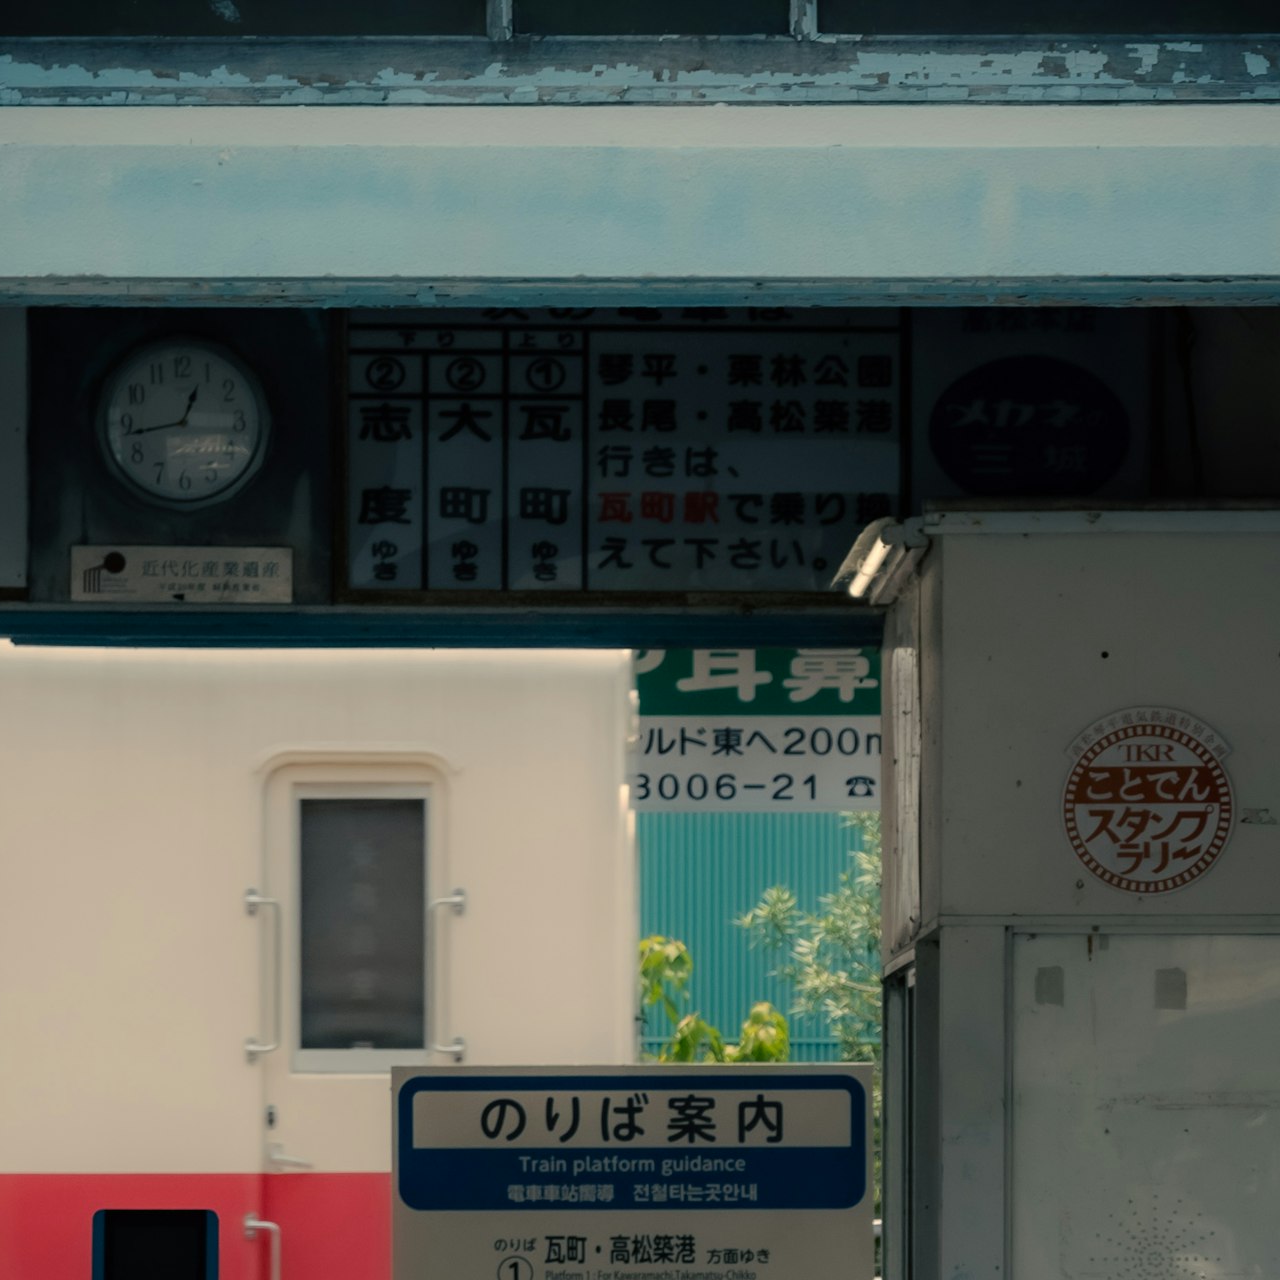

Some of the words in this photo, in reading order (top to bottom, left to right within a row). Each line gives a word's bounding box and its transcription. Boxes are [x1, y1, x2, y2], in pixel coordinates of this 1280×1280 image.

[150, 362, 164, 385] 11
[173, 355, 191, 378] 12
[203, 362, 211, 384] 1
[128, 382, 145, 405] 10
[222, 379, 236, 402] 2
[120, 412, 134, 436] 9
[232, 409, 247, 433] 3
[130, 441, 145, 464] 8
[223, 439, 235, 461] 4
[153, 462, 165, 485] 7
[178, 469, 192, 491] 6
[204, 460, 218, 482] 5
[1086, 768, 1210, 802] ことでん
[1085, 804, 1215, 844] スタンプ
[1116, 841, 1204, 876] ラリー
[480, 1092, 785, 1143] のりば案内
[519, 1156, 567, 1174] Train
[573, 1155, 655, 1177] platform
[661, 1156, 746, 1177] guidance
[493, 1237, 537, 1253] のりば
[544, 1234, 696, 1266] 瓦町・高松築港
[707, 1247, 771, 1265] 方面ゆき
[545, 1270, 584, 1280] Platform
[597, 1270, 613, 1280] For
